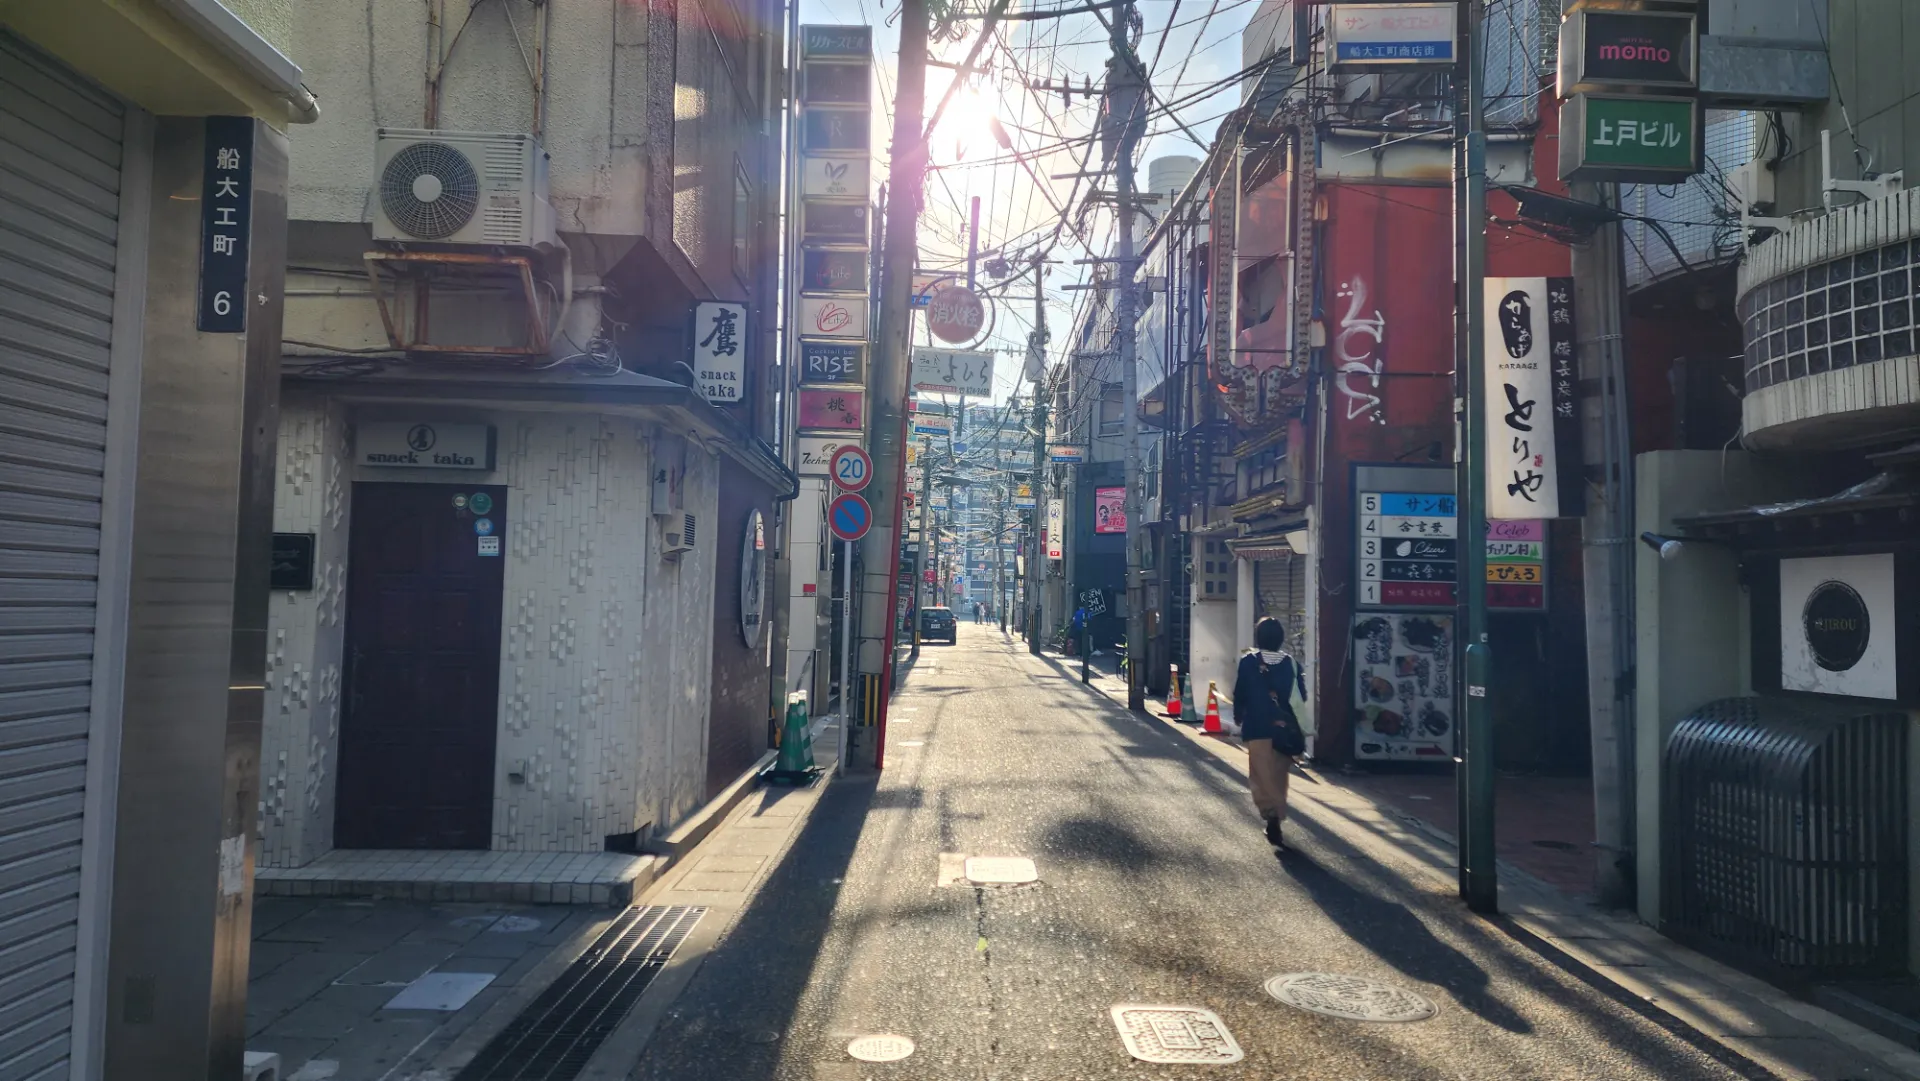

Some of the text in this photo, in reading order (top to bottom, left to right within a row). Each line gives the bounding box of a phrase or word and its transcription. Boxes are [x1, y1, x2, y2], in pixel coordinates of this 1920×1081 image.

[1350, 45, 1435, 57] 船大工町商店街
[1600, 45, 1671, 62] momo
[1593, 119, 1681, 148] 上戸ビル
[213, 147, 241, 315] 船大工町 6
[932, 301, 980, 328] 消火栓
[699, 307, 738, 357] 鷹
[1506, 300, 1532, 358] からあげ
[809, 355, 856, 373] RISE
[701, 370, 736, 381] snack
[702, 384, 736, 398] taka
[1504, 383, 1544, 502] とりや
[366, 451, 474, 465] snack taka
[839, 457, 863, 479] 20
[1366, 496, 1376, 511] 5
[1366, 520, 1376, 533] 4
[1399, 521, 1444, 534] 合言葉
[1495, 522, 1530, 537] Celeb
[1366, 541, 1376, 555] 3
[1366, 563, 1376, 577] 2
[1367, 585, 1373, 600] 1
